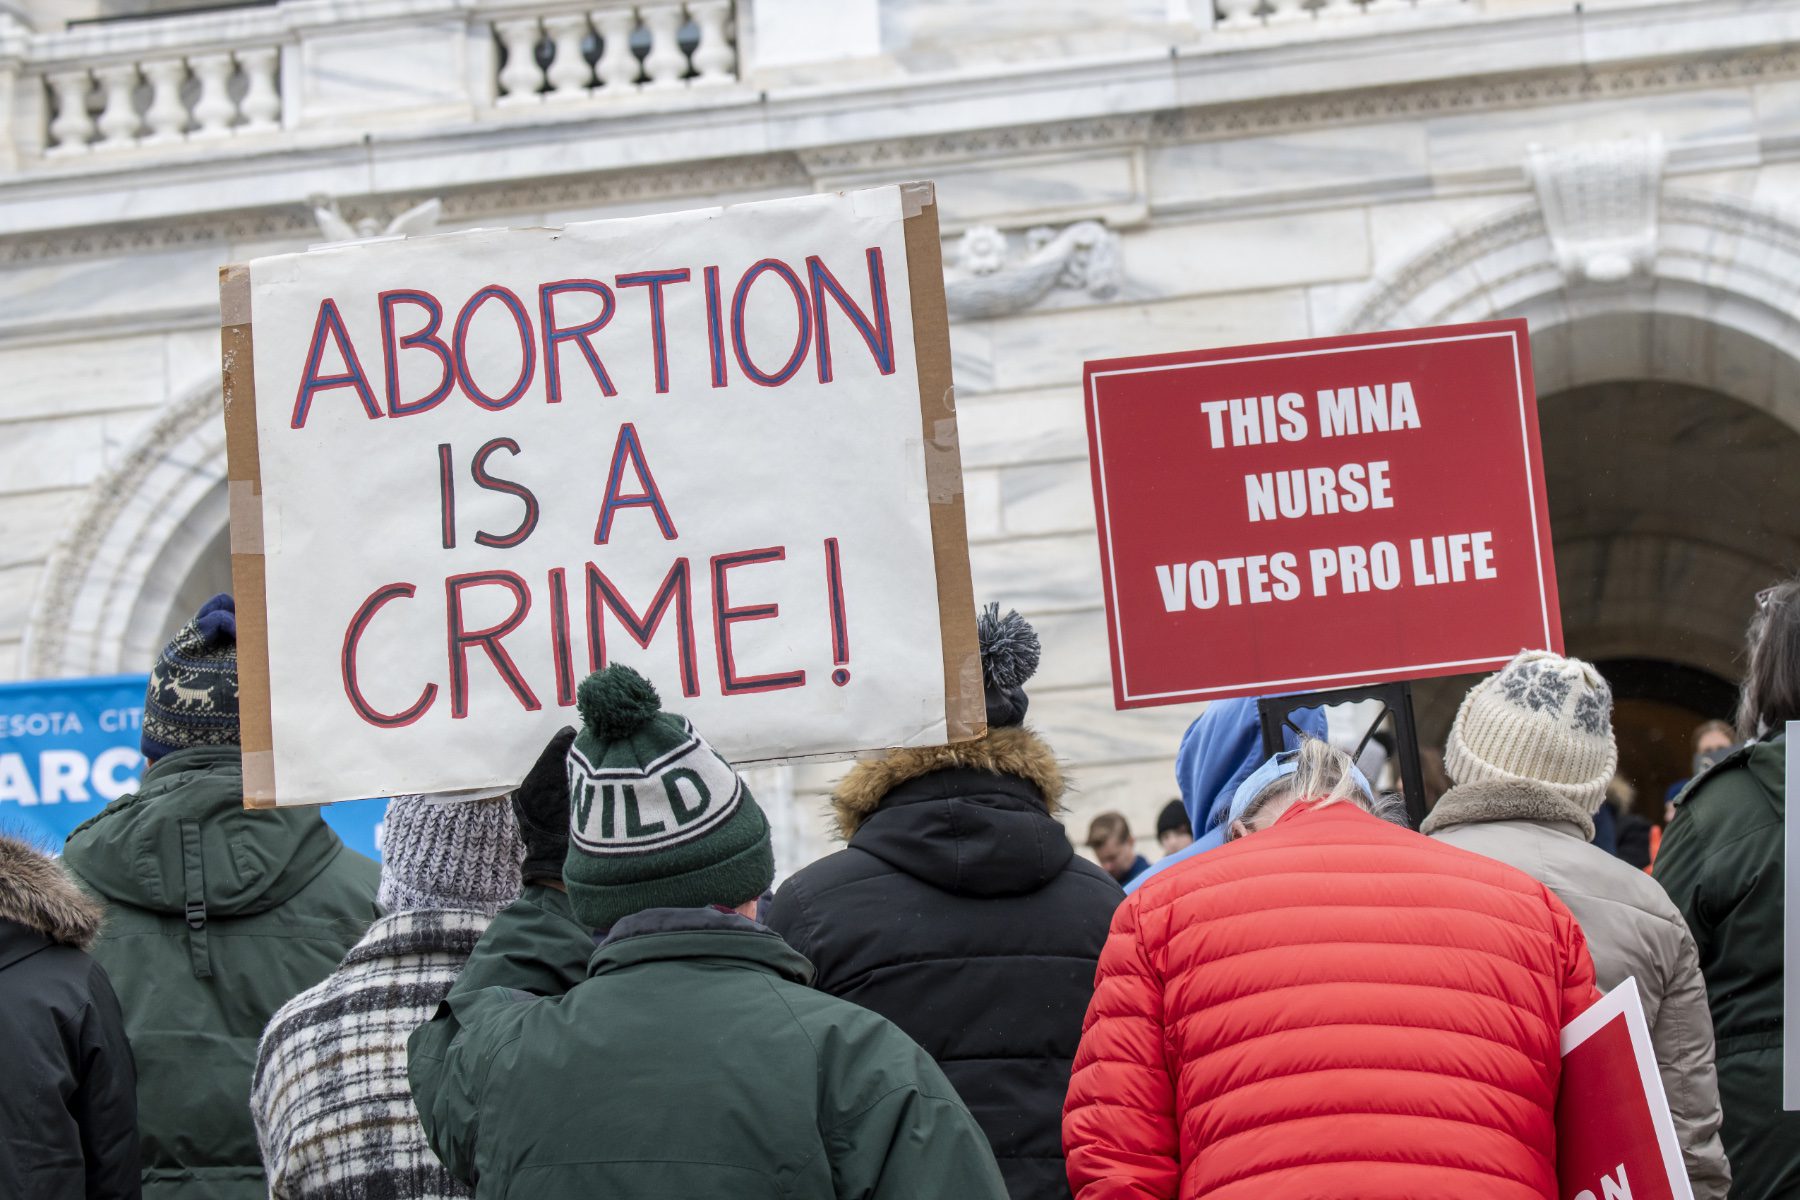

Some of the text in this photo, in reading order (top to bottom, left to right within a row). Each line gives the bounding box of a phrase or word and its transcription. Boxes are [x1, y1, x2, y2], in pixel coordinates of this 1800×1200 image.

[291, 247, 895, 430] ABORTION
[1201, 381, 1422, 449] THIS MNA
[439, 422, 678, 549] IS A
[1245, 460, 1395, 523] NURSE
[1155, 531, 1498, 613] VOTES PRO LIFE
[342, 536, 850, 729] CRIME!
[569, 761, 711, 838] WILD
[1573, 1162, 1634, 1200] N
